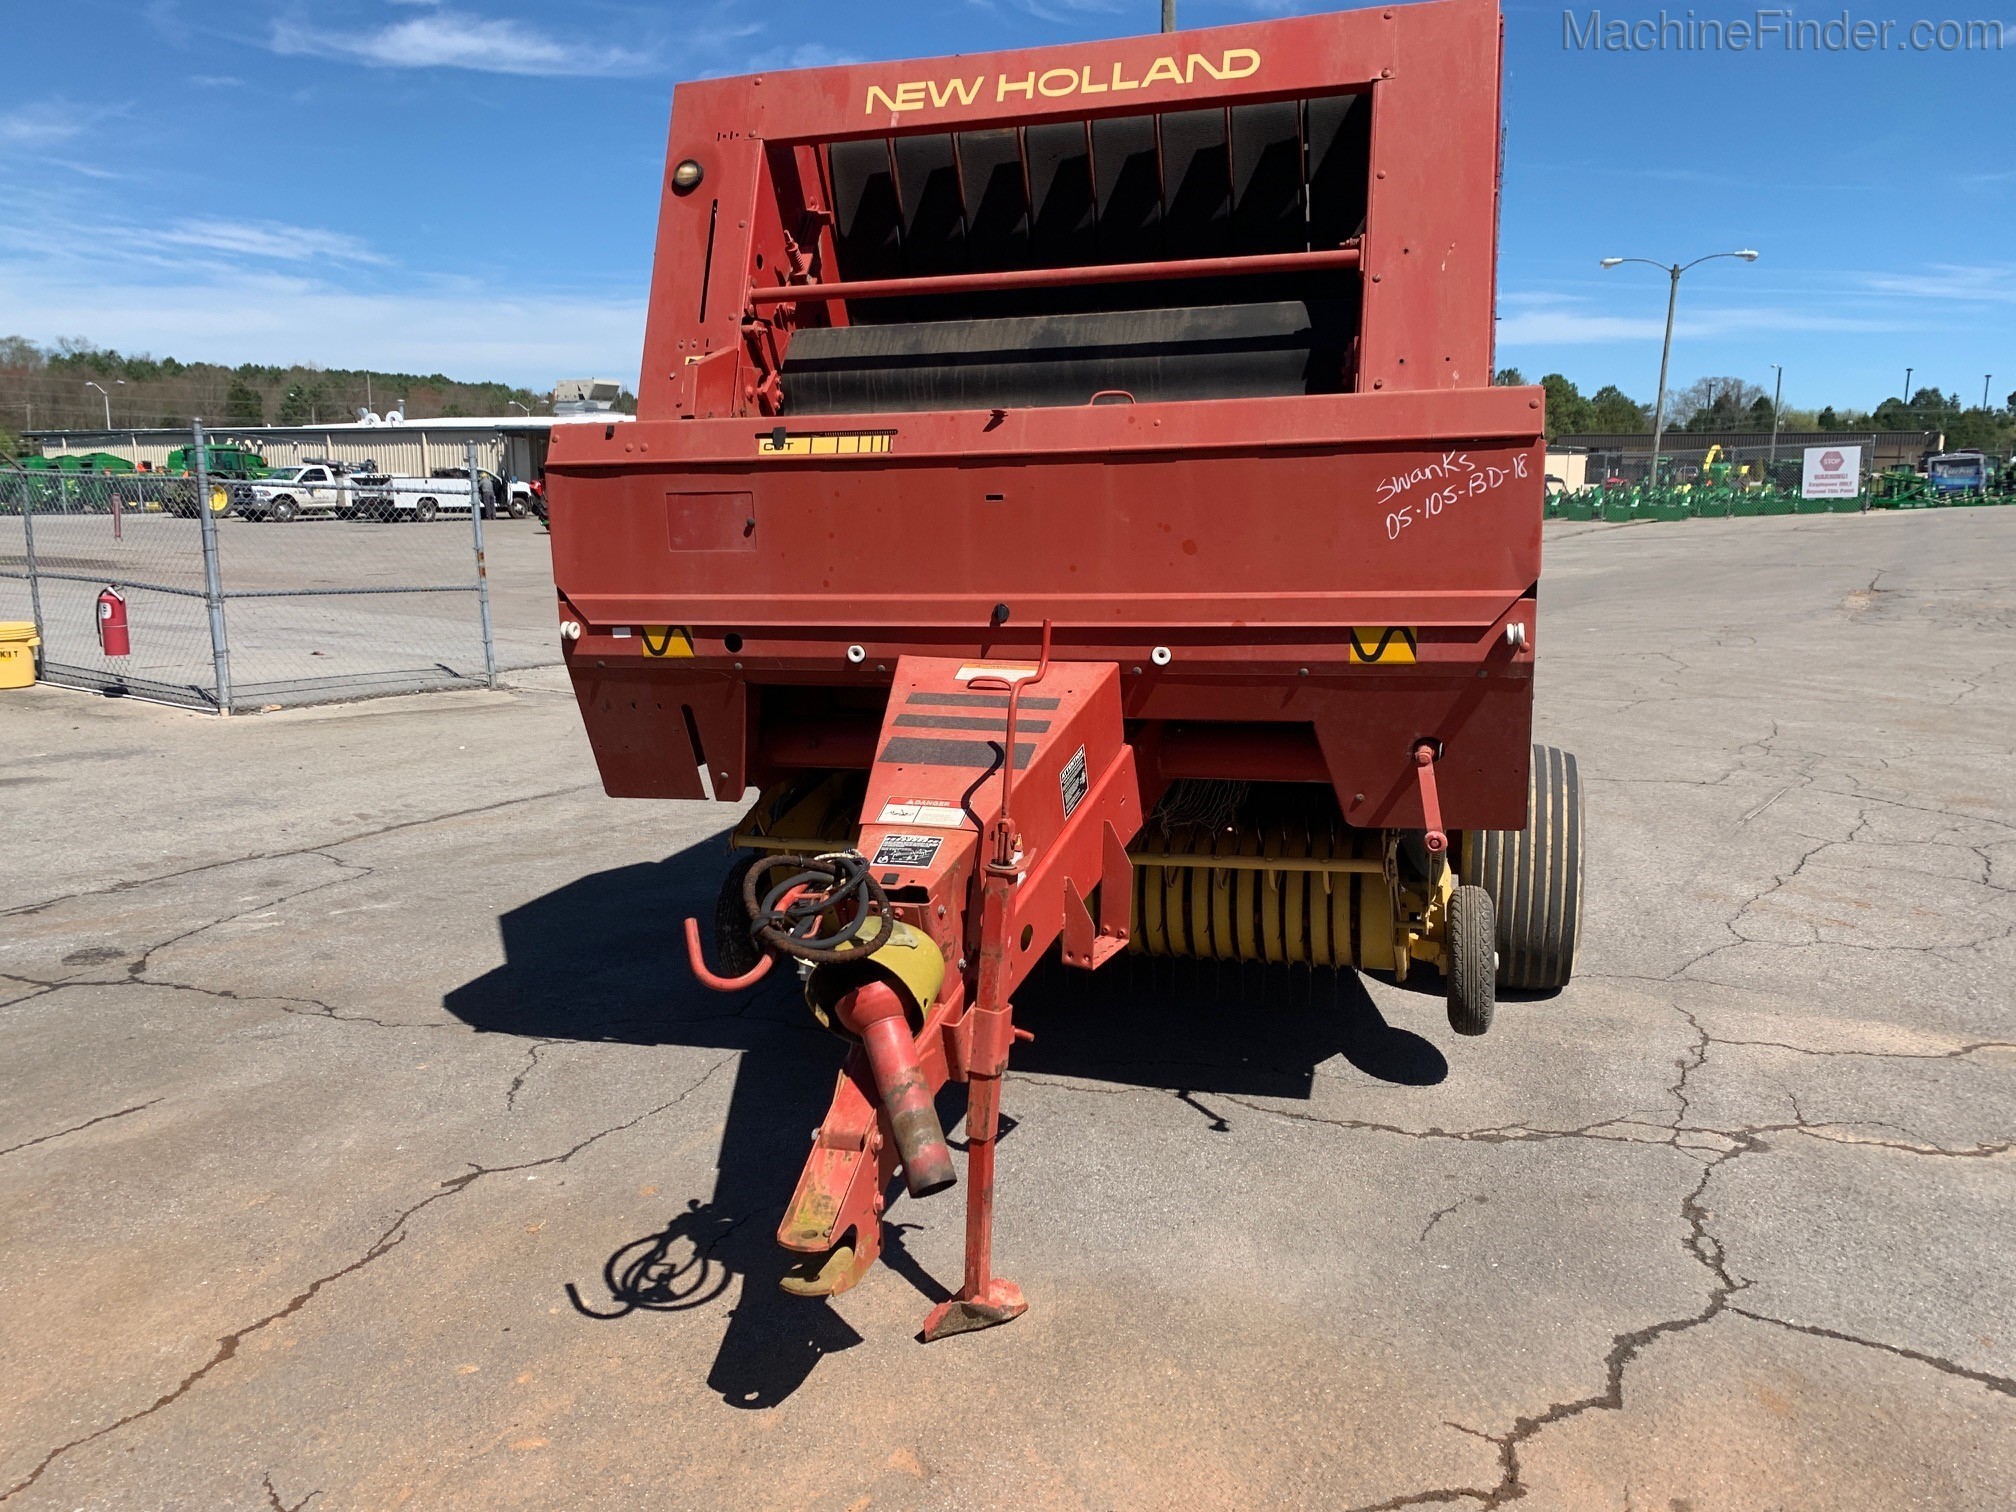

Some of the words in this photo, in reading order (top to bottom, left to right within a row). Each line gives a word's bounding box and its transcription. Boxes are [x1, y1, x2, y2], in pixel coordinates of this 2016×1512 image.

[865, 76, 984, 114] NEW
[996, 48, 1260, 103] HOLLAND
[914, 799, 950, 807] DANGER
